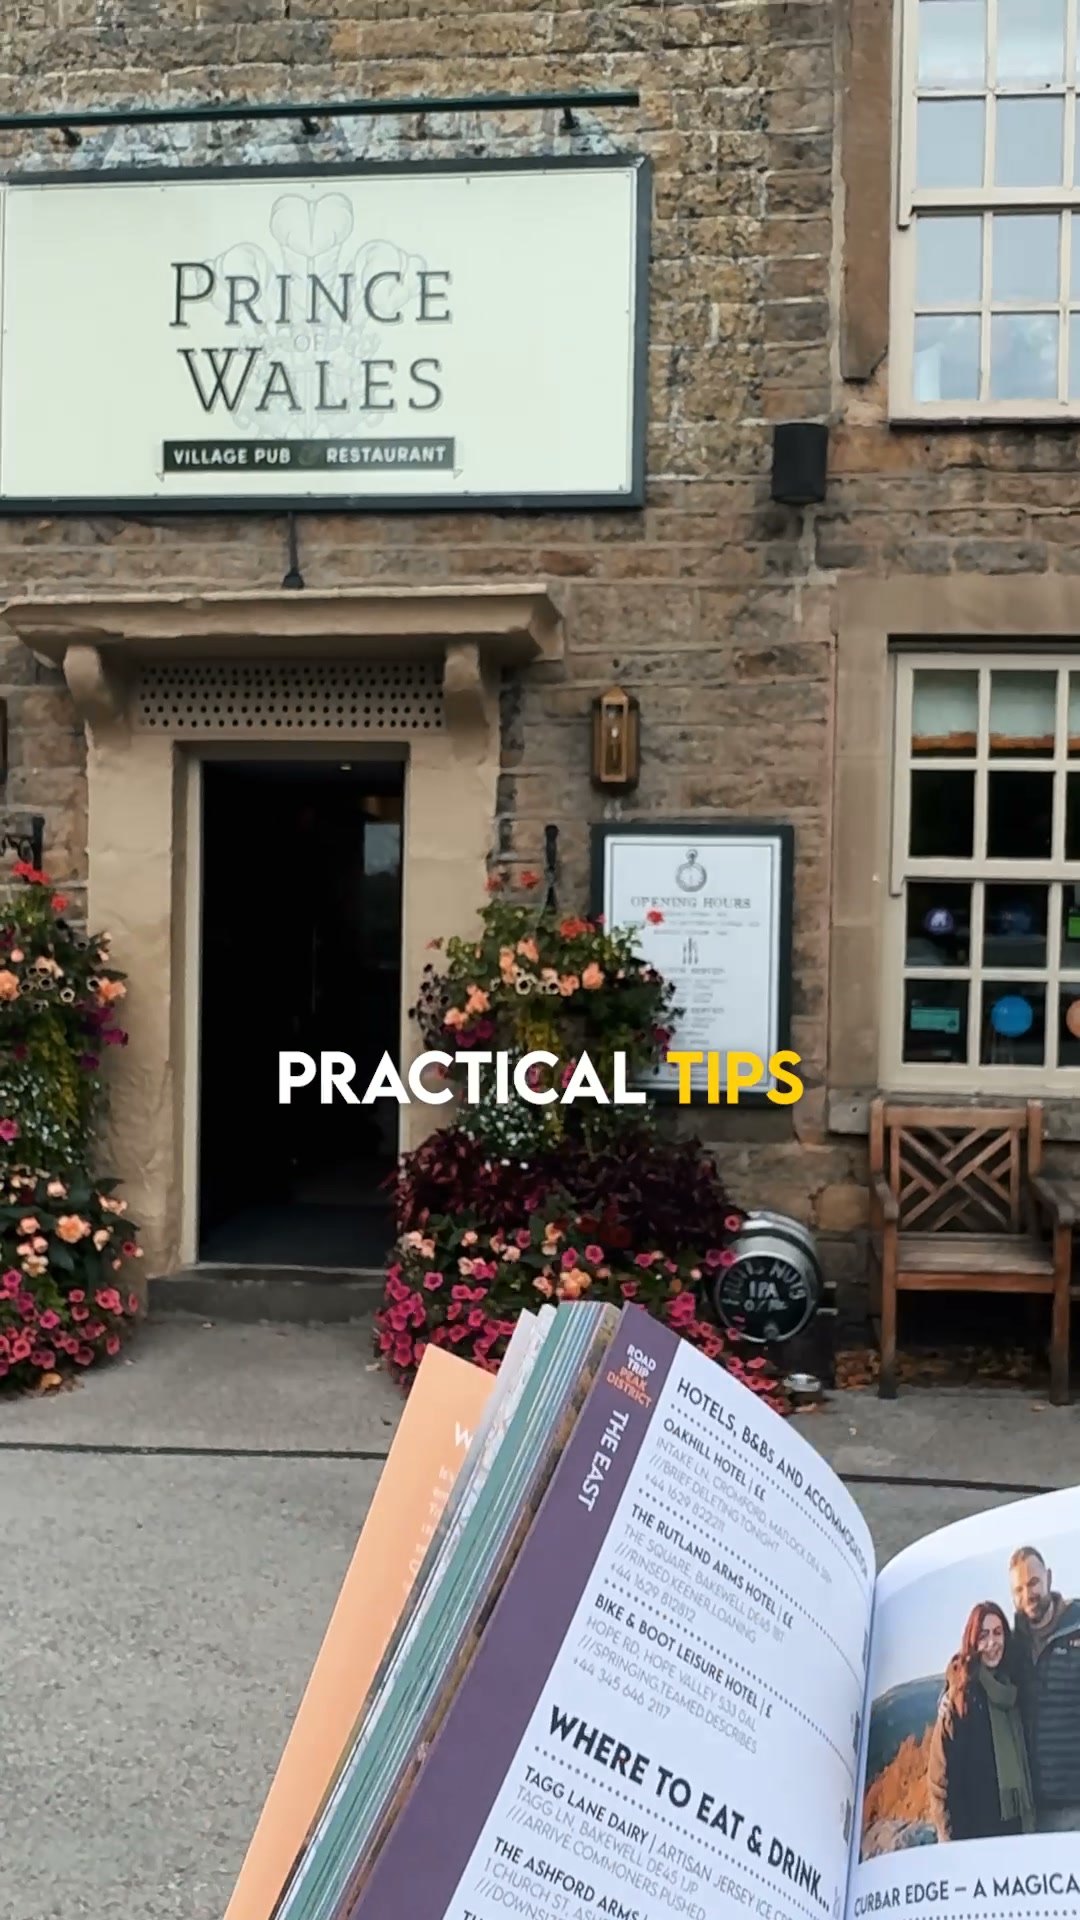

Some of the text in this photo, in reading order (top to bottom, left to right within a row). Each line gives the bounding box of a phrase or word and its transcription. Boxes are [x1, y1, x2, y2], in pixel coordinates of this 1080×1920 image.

[169, 262, 451, 327] PRINCE
[294, 334, 326, 352] OF
[177, 346, 443, 413] WALES
[173, 448, 248, 464] VILLAGE
[254, 448, 291, 463] PUB
[326, 445, 447, 463] RESTAURANT
[631, 896, 752, 909] OPENING HOURS
[607, 1371, 652, 1408] DISTRICT
[620, 1367, 647, 1391] PEAK
[626, 1344, 656, 1371] ROAD
[627, 1358, 649, 1378] TRIP
[578, 1410, 629, 1512] THE EAST
[664, 1418, 711, 1460] OAKHILL
[714, 1453, 746, 1486] HOTEL
[677, 1377, 737, 1438] HOTELS,
[776, 1457, 803, 1488] AND
[804, 1483, 868, 1579] ACCOMMO
[624, 1523, 646, 1547] THE
[631, 1503, 656, 1529] THE
[656, 1520, 711, 1565] RUTLAND
[712, 1560, 744, 1590] ARMS
[745, 1581, 776, 1615] HOTEL
[586, 1615, 621, 1644] HOPE
[643, 1648, 677, 1679] HOPE
[680, 1669, 718, 1703] VALLEY
[594, 1593, 625, 1621] BIKE
[625, 1612, 636, 1629] &
[639, 1619, 676, 1652] BOOT
[676, 1643, 724, 1684] LEISURE
[724, 1674, 758, 1709] HOTEL
[549, 1704, 650, 1785] WHERE
[655, 1765, 692, 1808] TO
[696, 1792, 745, 1840] EAT
[747, 1824, 762, 1857] &
[516, 1784, 553, 1816] TAGG
[580, 1820, 643, 1867] BAKEWELL
[524, 1765, 565, 1799] TAGG
[568, 1790, 606, 1822] LANE
[607, 1812, 649, 1845] DAIRY
[657, 1842, 713, 1882] ARTISAN
[713, 1874, 755, 1907] JERSEY
[493, 1862, 550, 1903] CHURCH
[494, 1836, 523, 1864] THE
[523, 1856, 595, 1902] ASHFORD
[854, 1887, 900, 1917] CURBAR
[905, 1879, 949, 1904] EDGE
[973, 1878, 988, 1898] A
